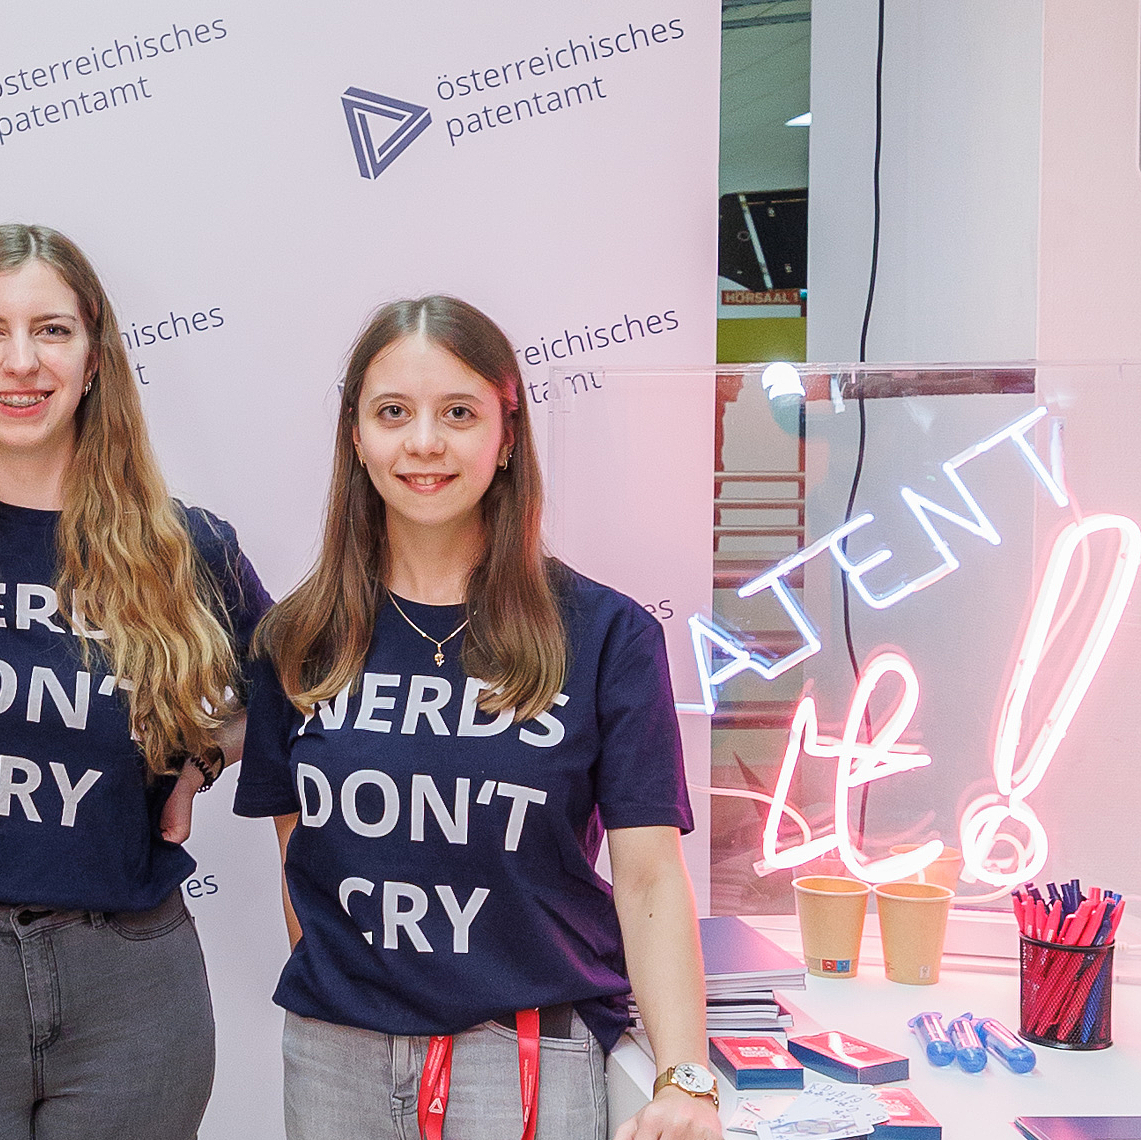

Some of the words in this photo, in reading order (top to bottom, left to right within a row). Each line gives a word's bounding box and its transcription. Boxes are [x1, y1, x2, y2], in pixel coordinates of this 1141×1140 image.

[437, 18, 684, 101] österreichisches
[446, 76, 607, 147] patentamt
[516, 310, 679, 366] eichisches
[688, 405, 1070, 715] ATENT
[296, 762, 548, 852] DON'T
[338, 876, 491, 954] CRY
